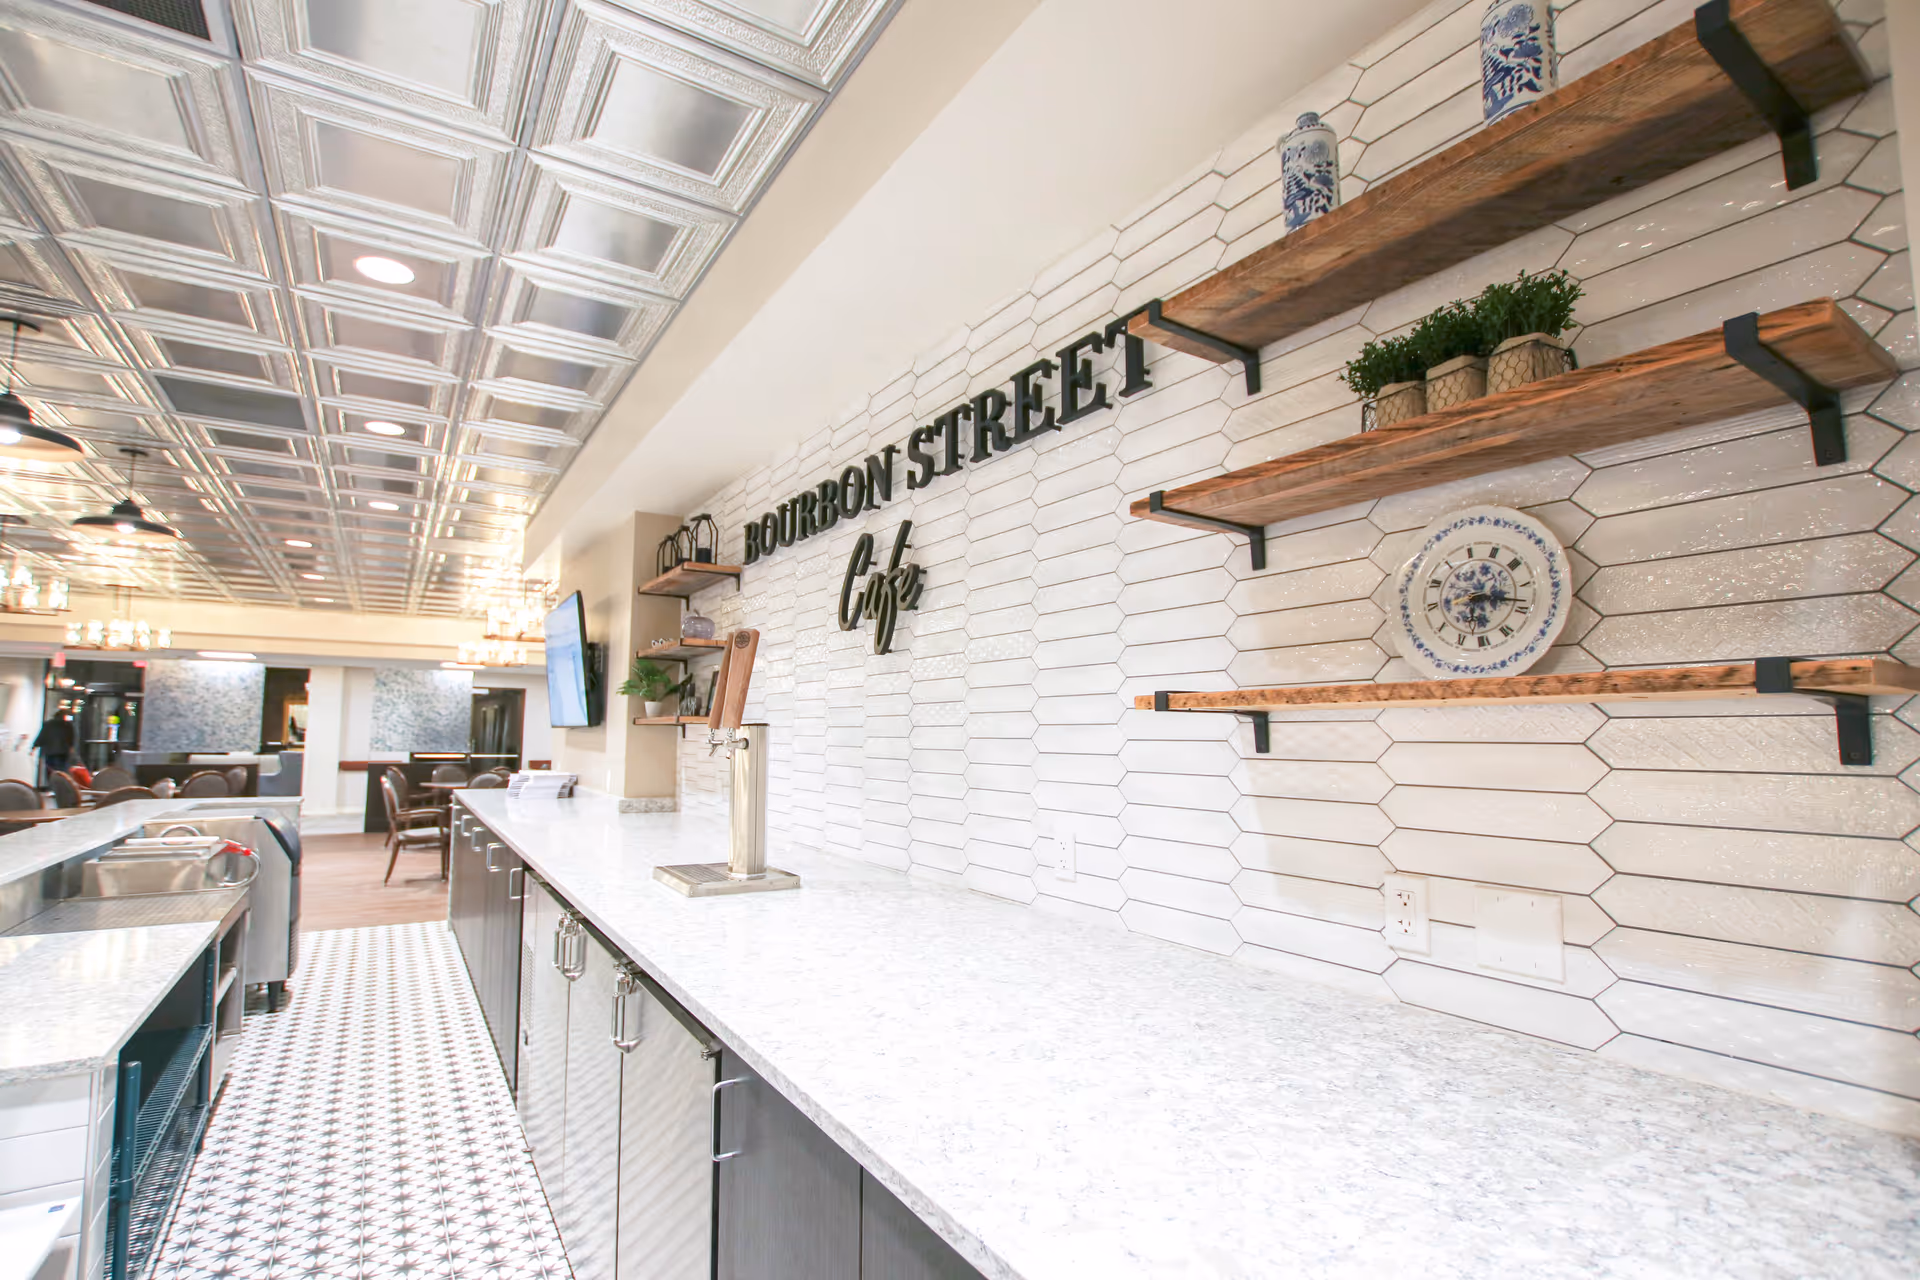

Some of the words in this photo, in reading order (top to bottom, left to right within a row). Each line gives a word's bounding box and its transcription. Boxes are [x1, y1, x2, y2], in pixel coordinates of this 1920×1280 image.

[743, 444, 898, 565] BOURBON
[906, 311, 1153, 490] STREET
[838, 519, 925, 655] Cafe
